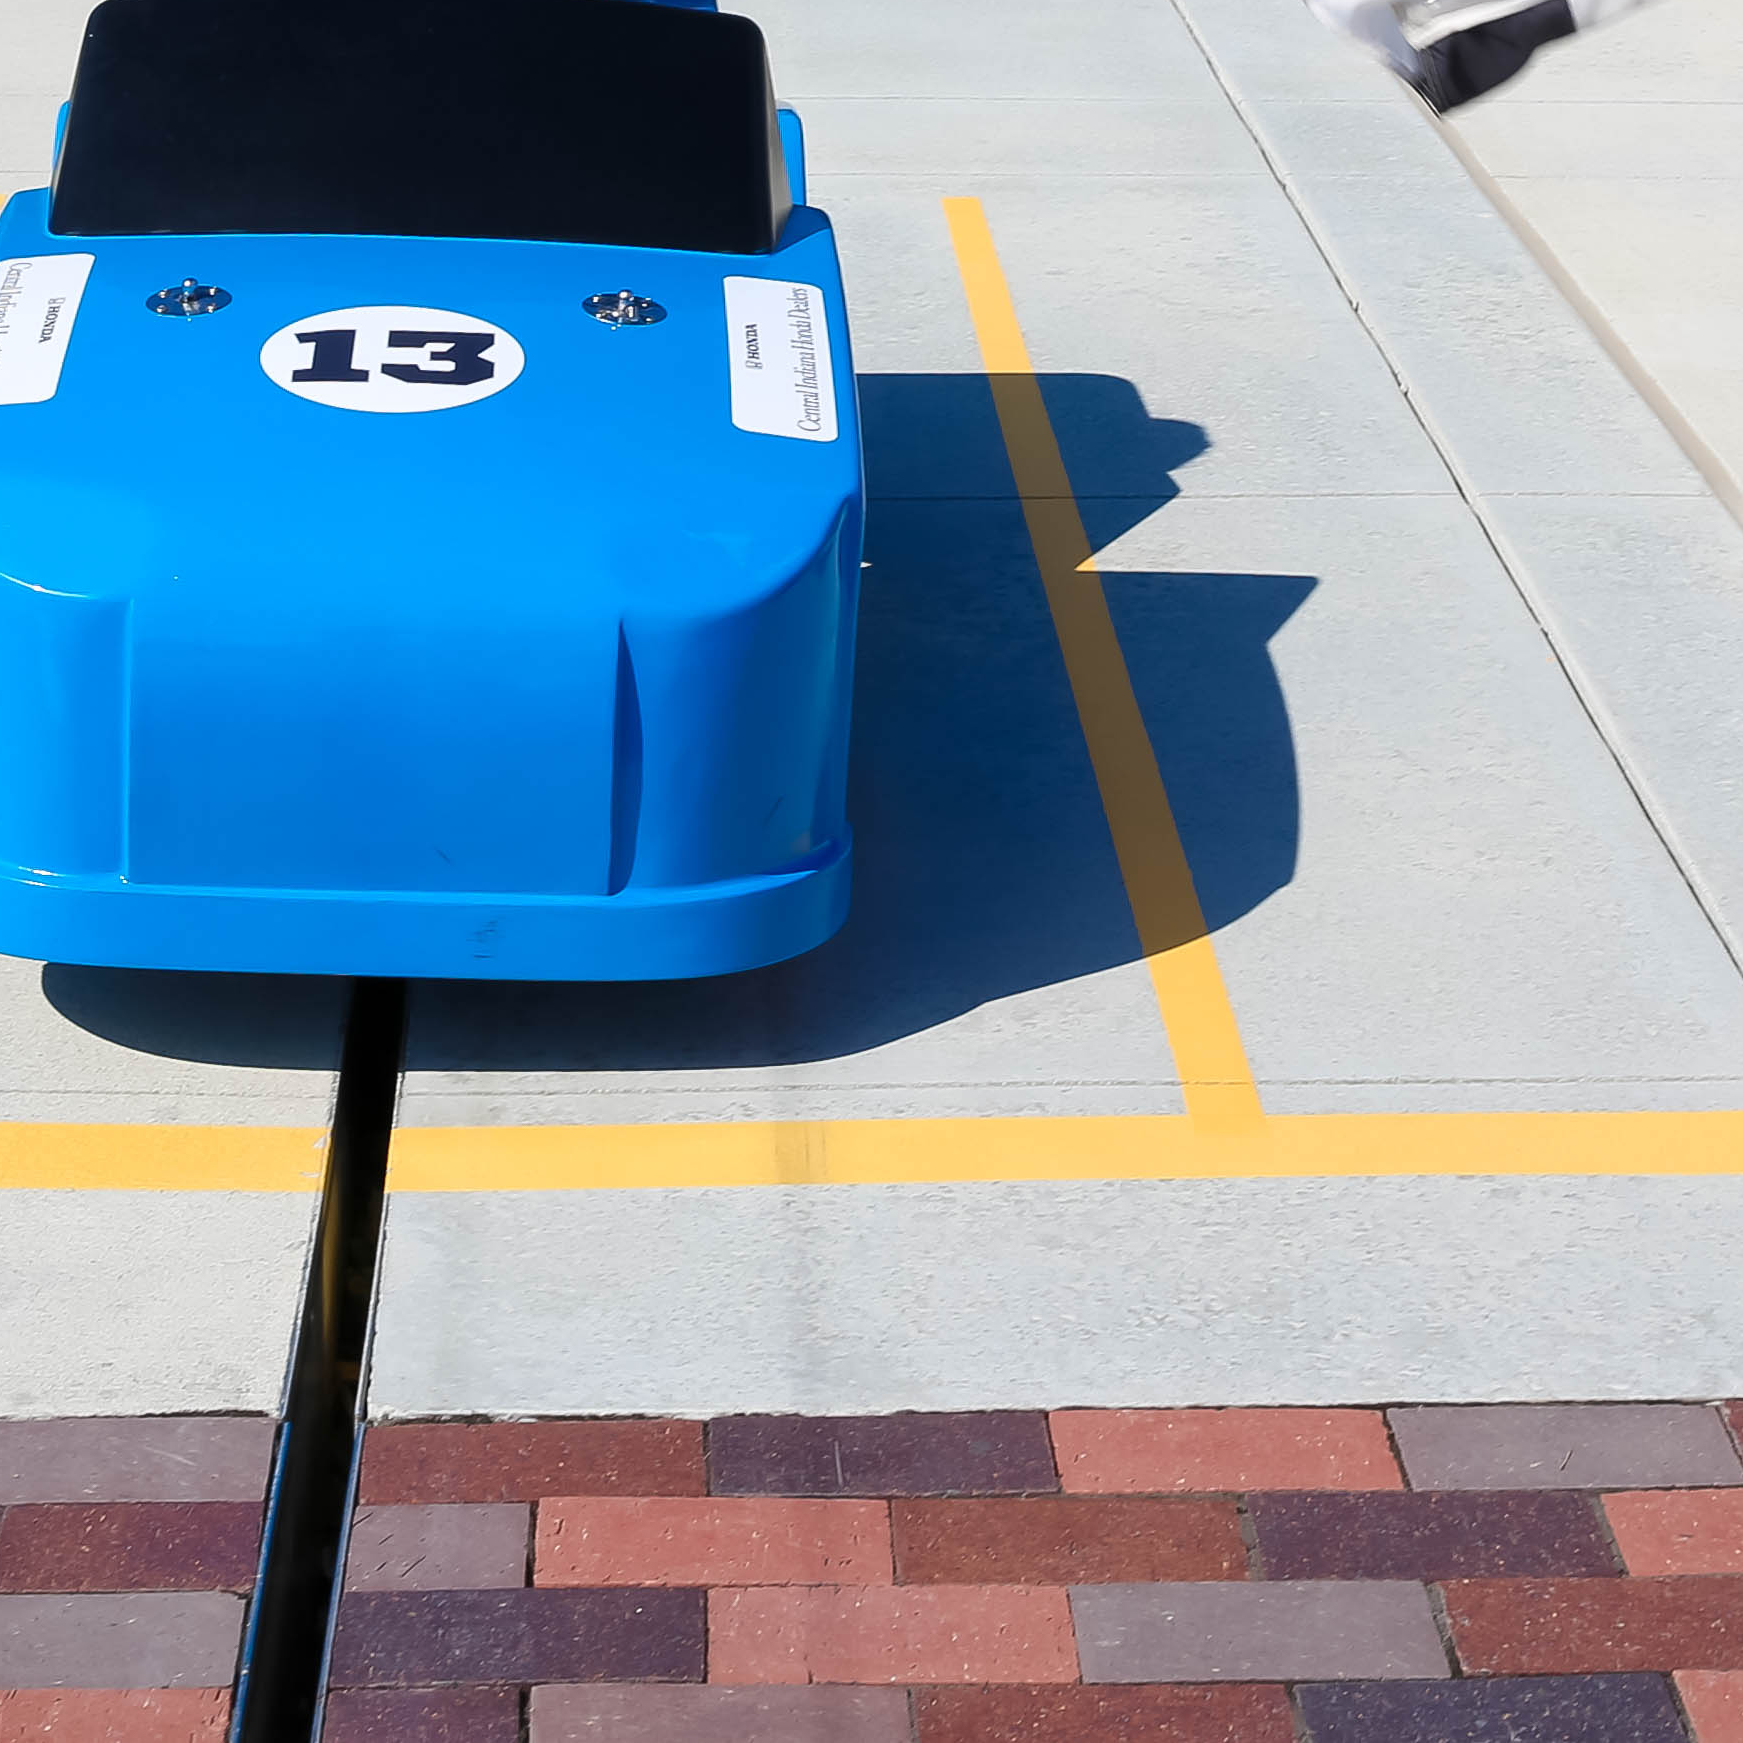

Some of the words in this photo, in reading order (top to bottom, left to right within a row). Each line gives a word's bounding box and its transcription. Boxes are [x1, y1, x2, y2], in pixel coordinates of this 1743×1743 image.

[1, 262, 33, 291] Central
[786, 287, 812, 320] Dealers
[38, 305, 61, 344] HONDA
[745, 323, 761, 360] HONDA
[789, 320, 816, 351] Honda
[291, 329, 495, 386] 13
[793, 351, 819, 390] Indiana
[794, 389, 823, 432] Central
